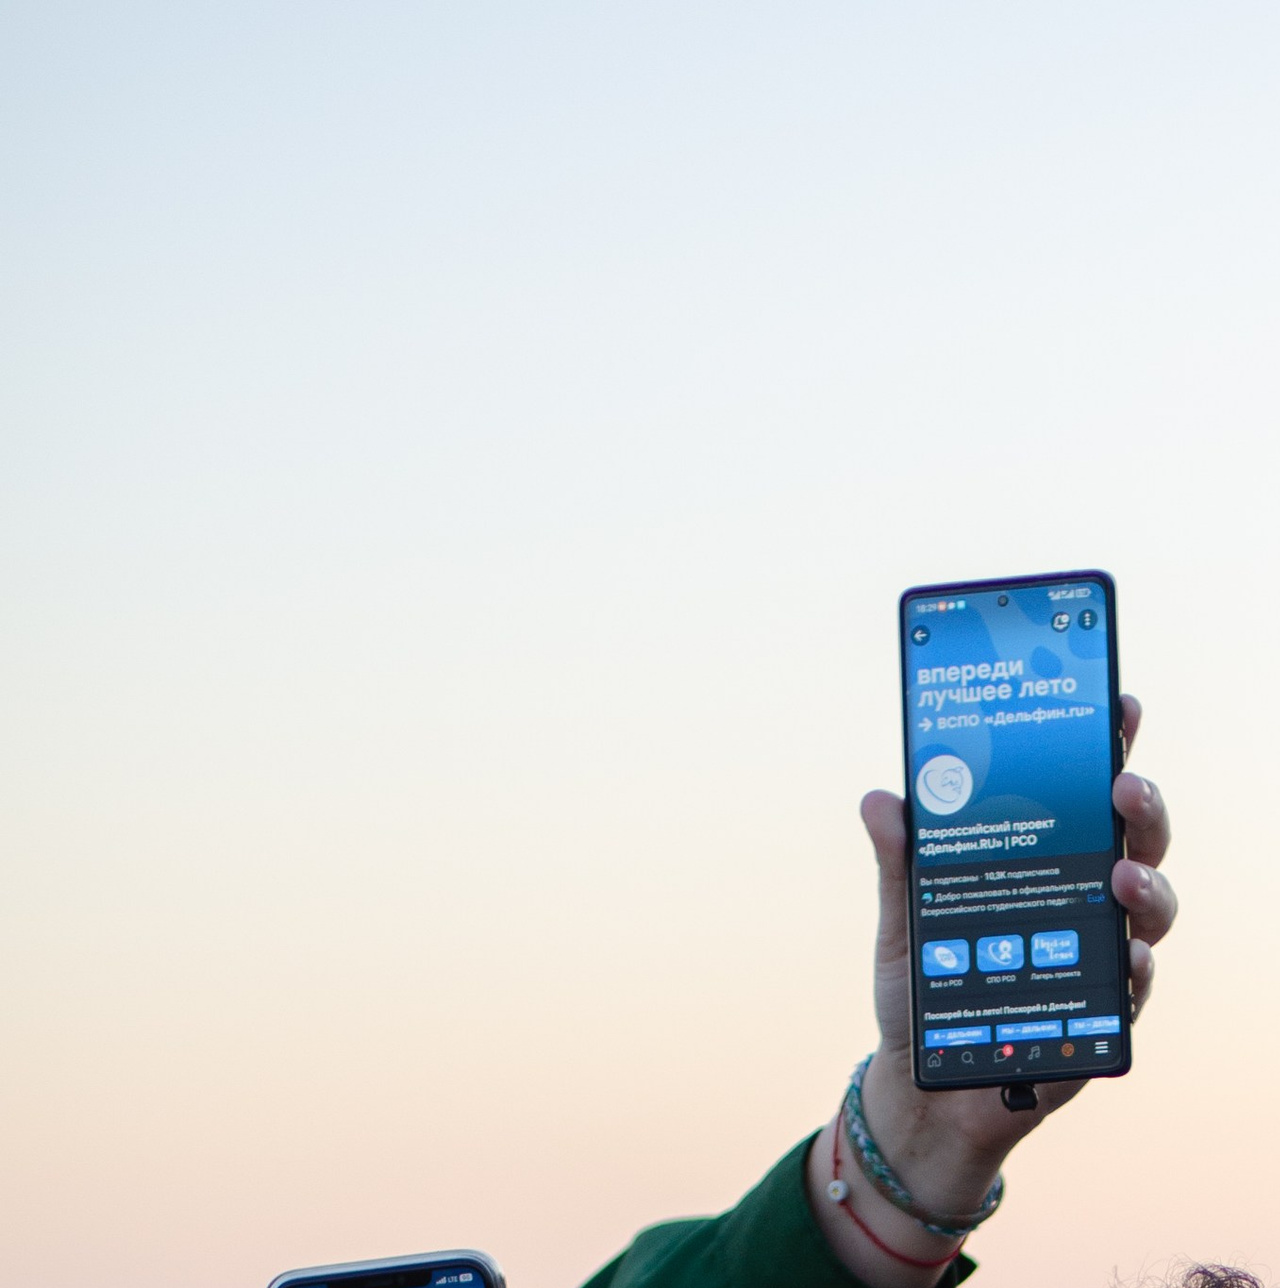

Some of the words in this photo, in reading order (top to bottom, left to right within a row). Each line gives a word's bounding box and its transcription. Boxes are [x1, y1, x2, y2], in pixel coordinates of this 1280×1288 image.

[916, 660, 1024, 688] впереди
[916, 683, 1013, 712] лучшее
[1018, 677, 1077, 697] лето
[937, 714, 979, 728] ВСПО
[984, 704, 1095, 726] «Дельфин.ru»
[917, 821, 1010, 840] Всероссийский
[1012, 818, 1056, 831] проект
[918, 836, 1002, 856] «Дельфин.RU»
[1011, 834, 1037, 847] РСО
